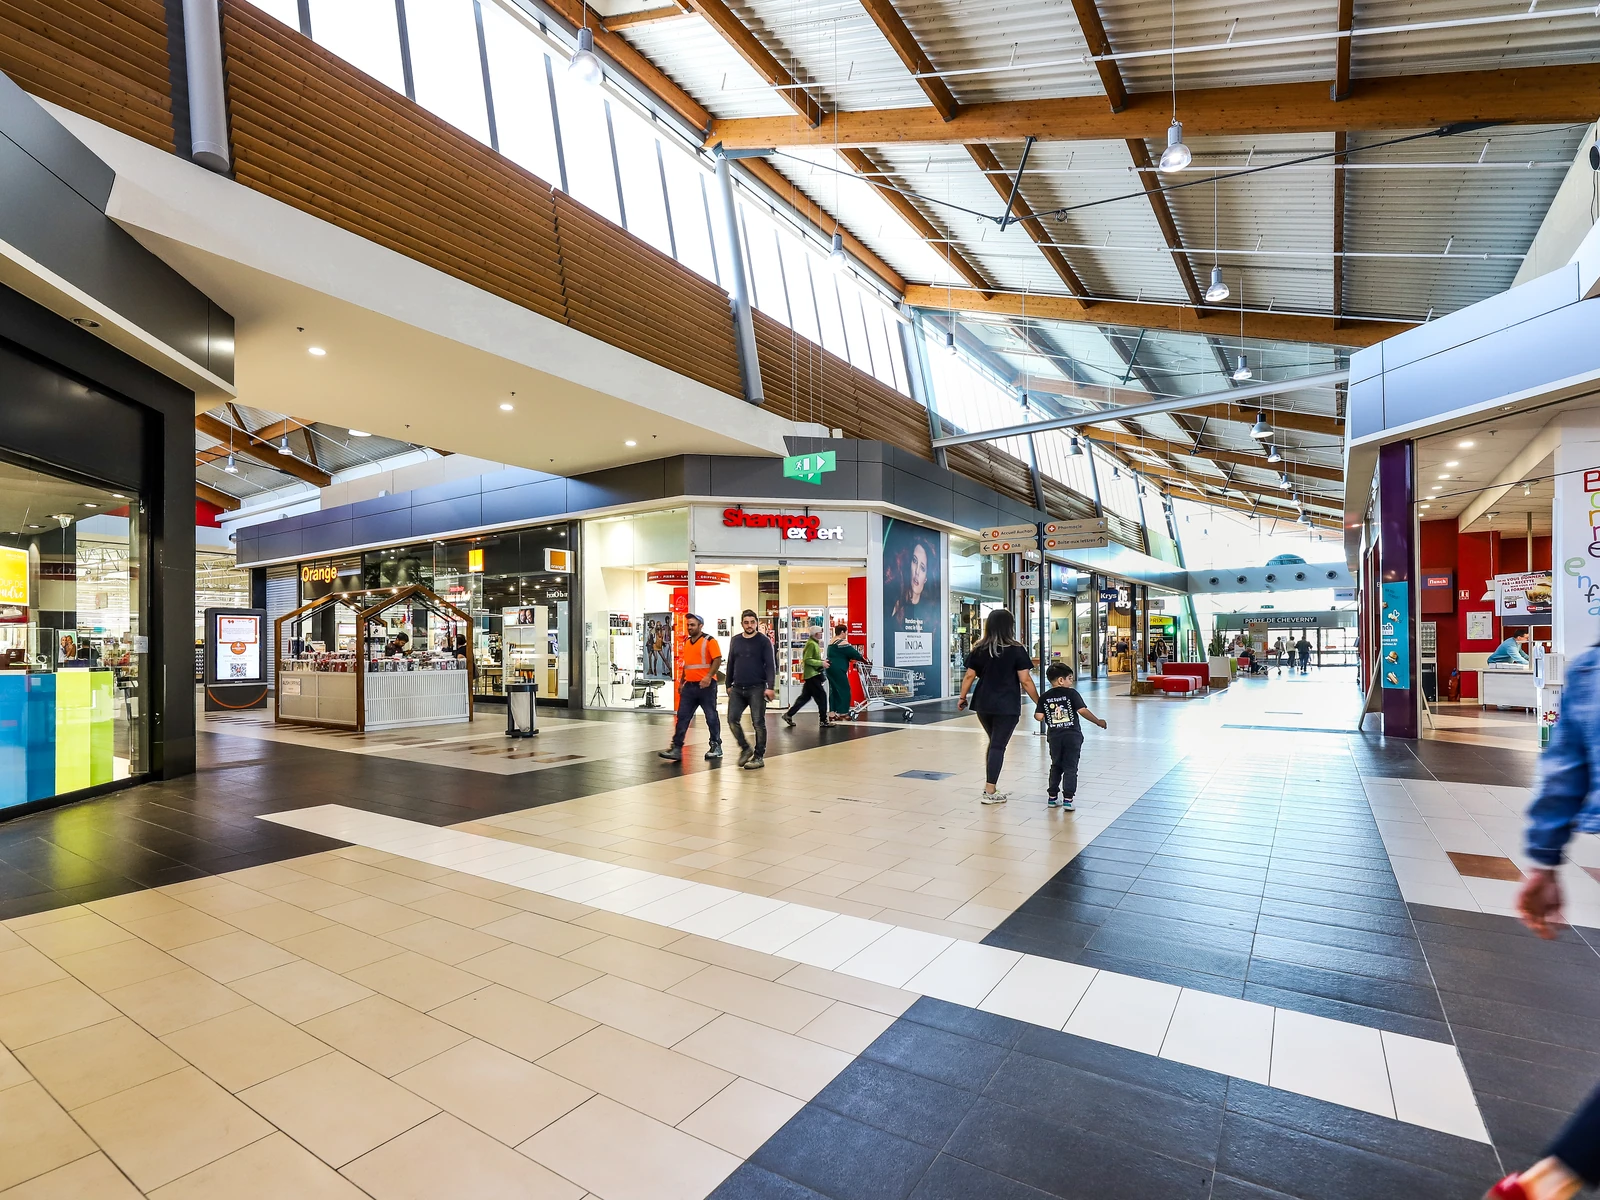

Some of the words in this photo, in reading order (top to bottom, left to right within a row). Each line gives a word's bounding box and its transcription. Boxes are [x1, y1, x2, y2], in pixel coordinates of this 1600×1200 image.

[723, 508, 820, 540] Shampoo
[787, 526, 843, 542] expert
[302, 566, 338, 583] Orange
[1020, 579, 1035, 587] C&C
[1100, 592, 1117, 600] Krys
